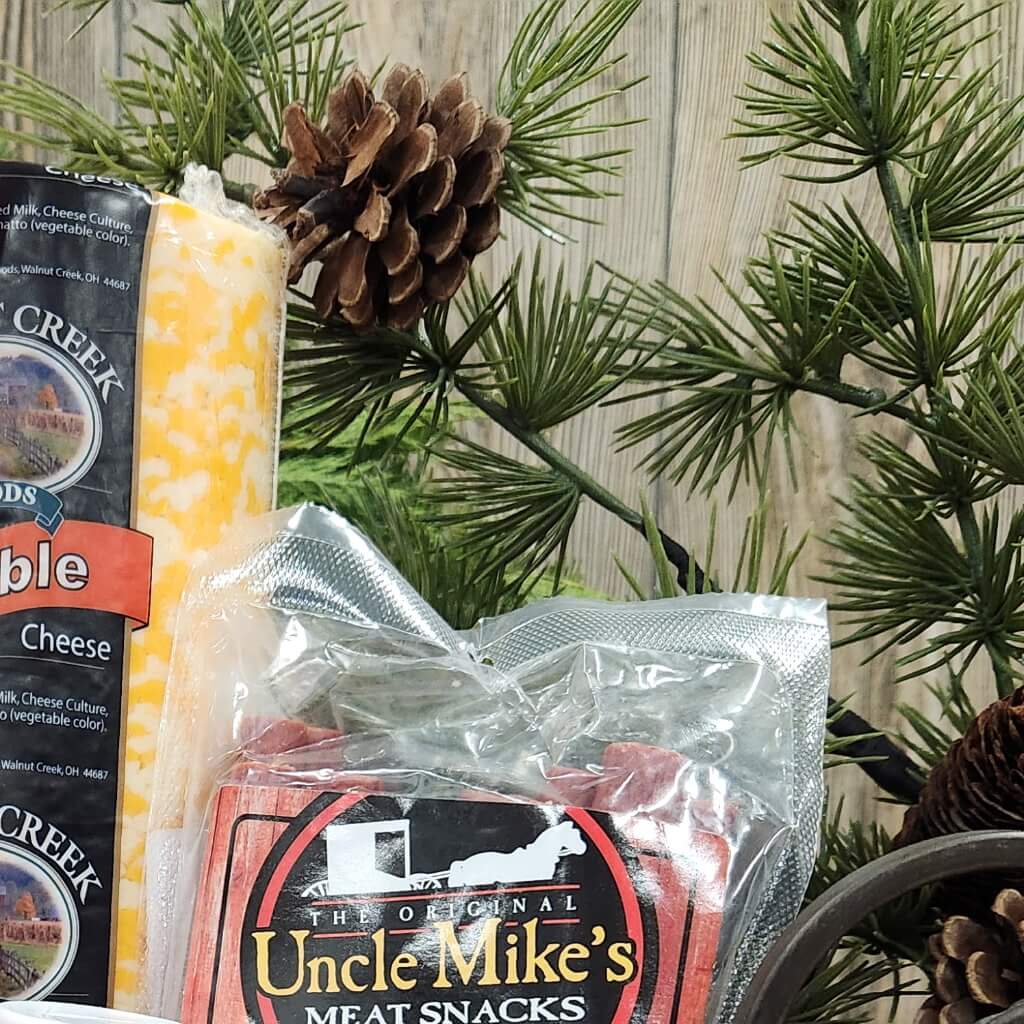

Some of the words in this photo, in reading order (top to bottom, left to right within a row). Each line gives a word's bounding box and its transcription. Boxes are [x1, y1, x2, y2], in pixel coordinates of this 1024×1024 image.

[14, 204, 41, 218] Milk,
[43, 206, 86, 221] Cheese
[89, 213, 134, 233] Culture,
[30, 220, 92, 237] (vegetable
[96, 229, 130, 247] color).
[21, 265, 53, 276] Walnut
[56, 268, 84, 282] Creek,
[86, 273, 100, 285] OH
[104, 278, 131, 291] 44687
[13, 304, 126, 404] CREEK
[21, 623, 112, 661] Cheese
[22, 692, 63, 709] Cheese
[66, 699, 109, 717] Culture,
[10, 710, 70, 726] (vegetable
[73, 716, 108, 733] color).
[1, 759, 34, 771] Walnut
[36, 762, 64, 776] Creek,
[65, 766, 79, 776] OH
[83, 768, 108, 781] 44687
[310, 906, 369, 928] THE
[400, 895, 578, 923] ORIGINAL
[251, 928, 418, 997] Uncle
[432, 917, 636, 989] Mike's
